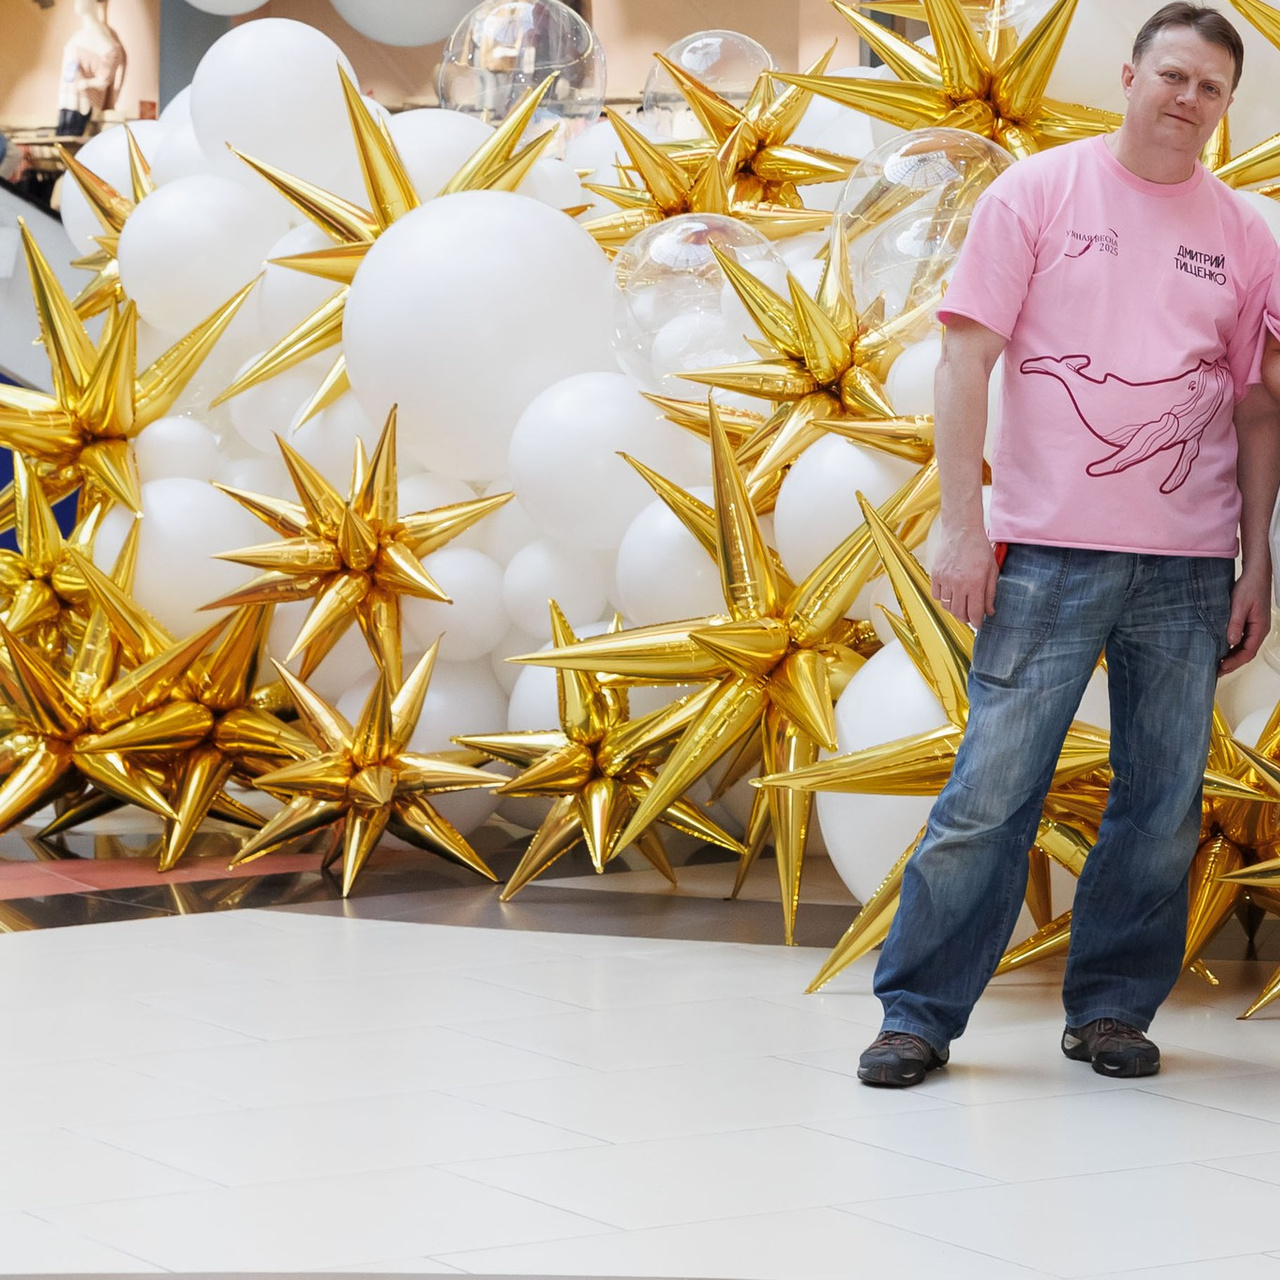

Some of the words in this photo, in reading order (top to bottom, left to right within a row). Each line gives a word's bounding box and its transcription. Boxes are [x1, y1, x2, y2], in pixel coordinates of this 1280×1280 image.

[1099, 243, 1119, 257] 2025
[1177, 244, 1225, 269] ДМИТРИЙ
[1174, 256, 1227, 286] ТИЩЕНКО
